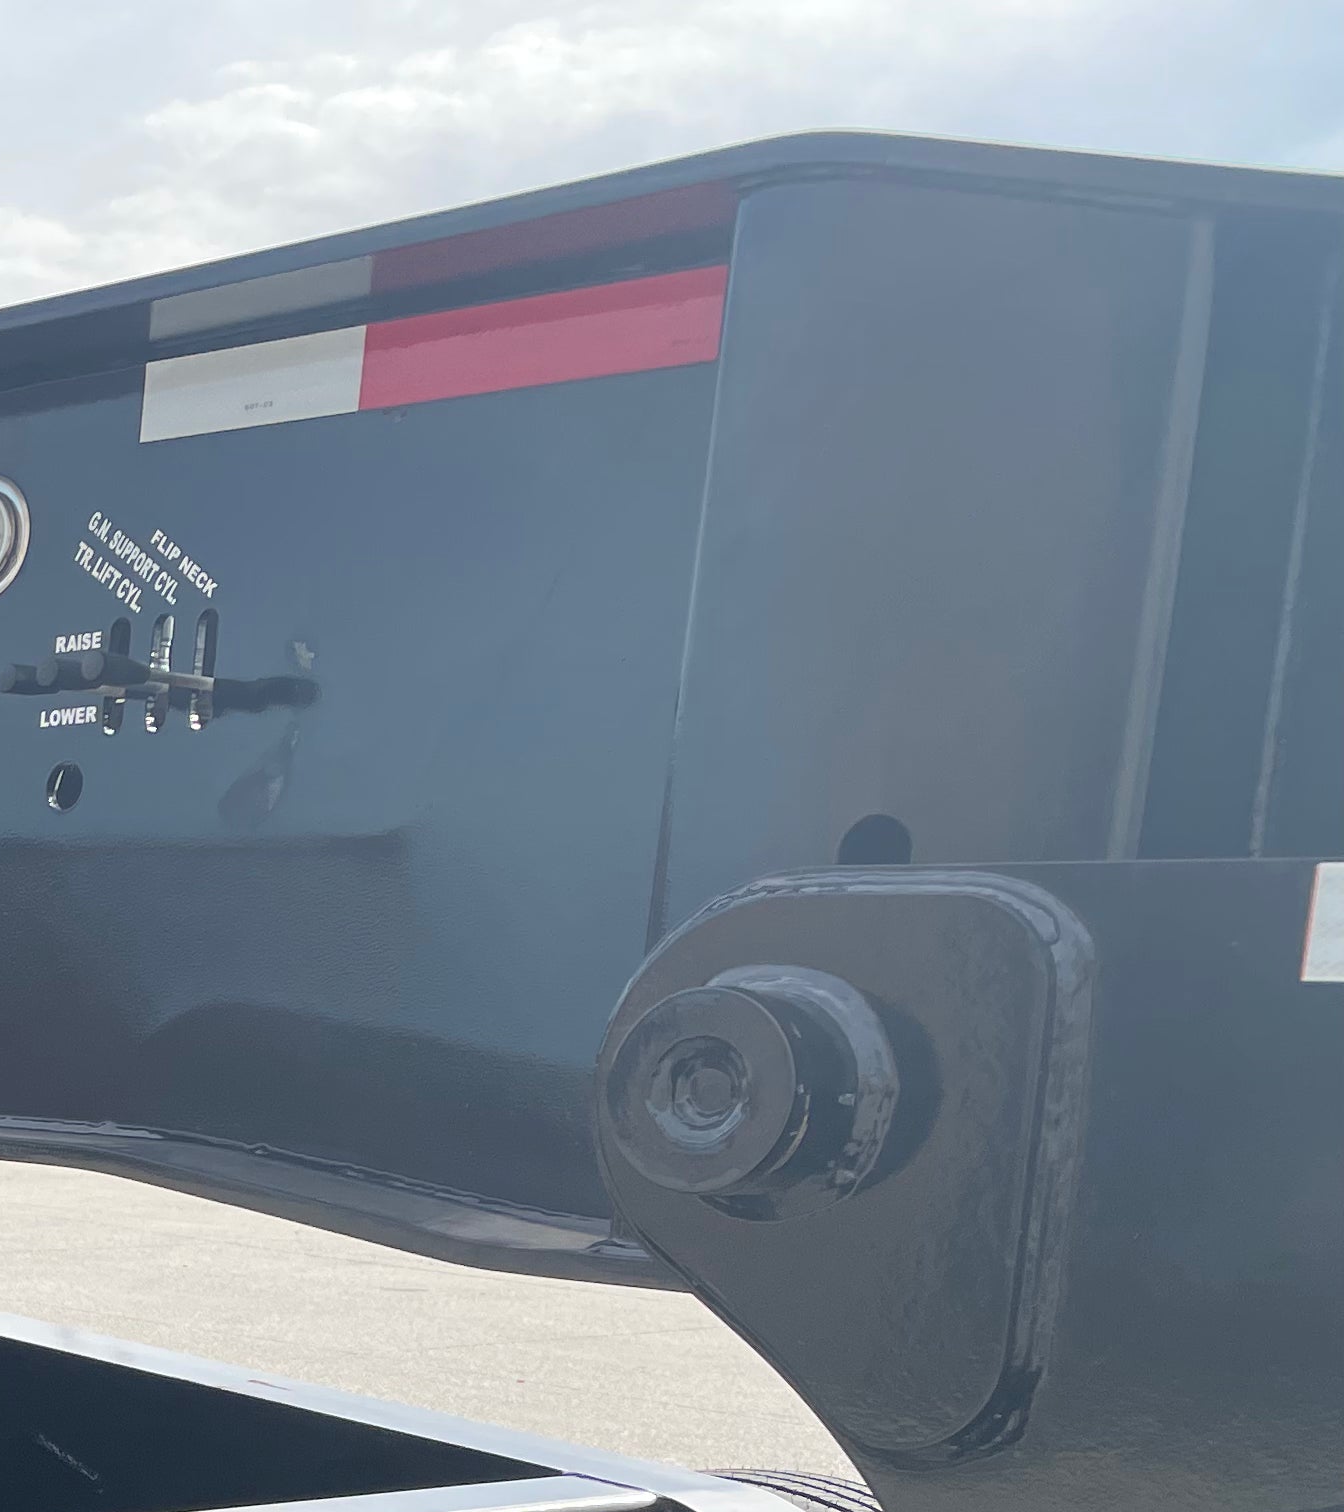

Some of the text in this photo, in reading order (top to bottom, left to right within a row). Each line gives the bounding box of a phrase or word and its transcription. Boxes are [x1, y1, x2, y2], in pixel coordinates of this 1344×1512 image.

[74, 540, 142, 614] TR. LIFT CYL.
[88, 511, 179, 605] G.N. SUPPORT CYL.
[150, 529, 219, 598] FLIP NECK
[55, 630, 102, 654] RAISE
[39, 705, 97, 728] LOWER
